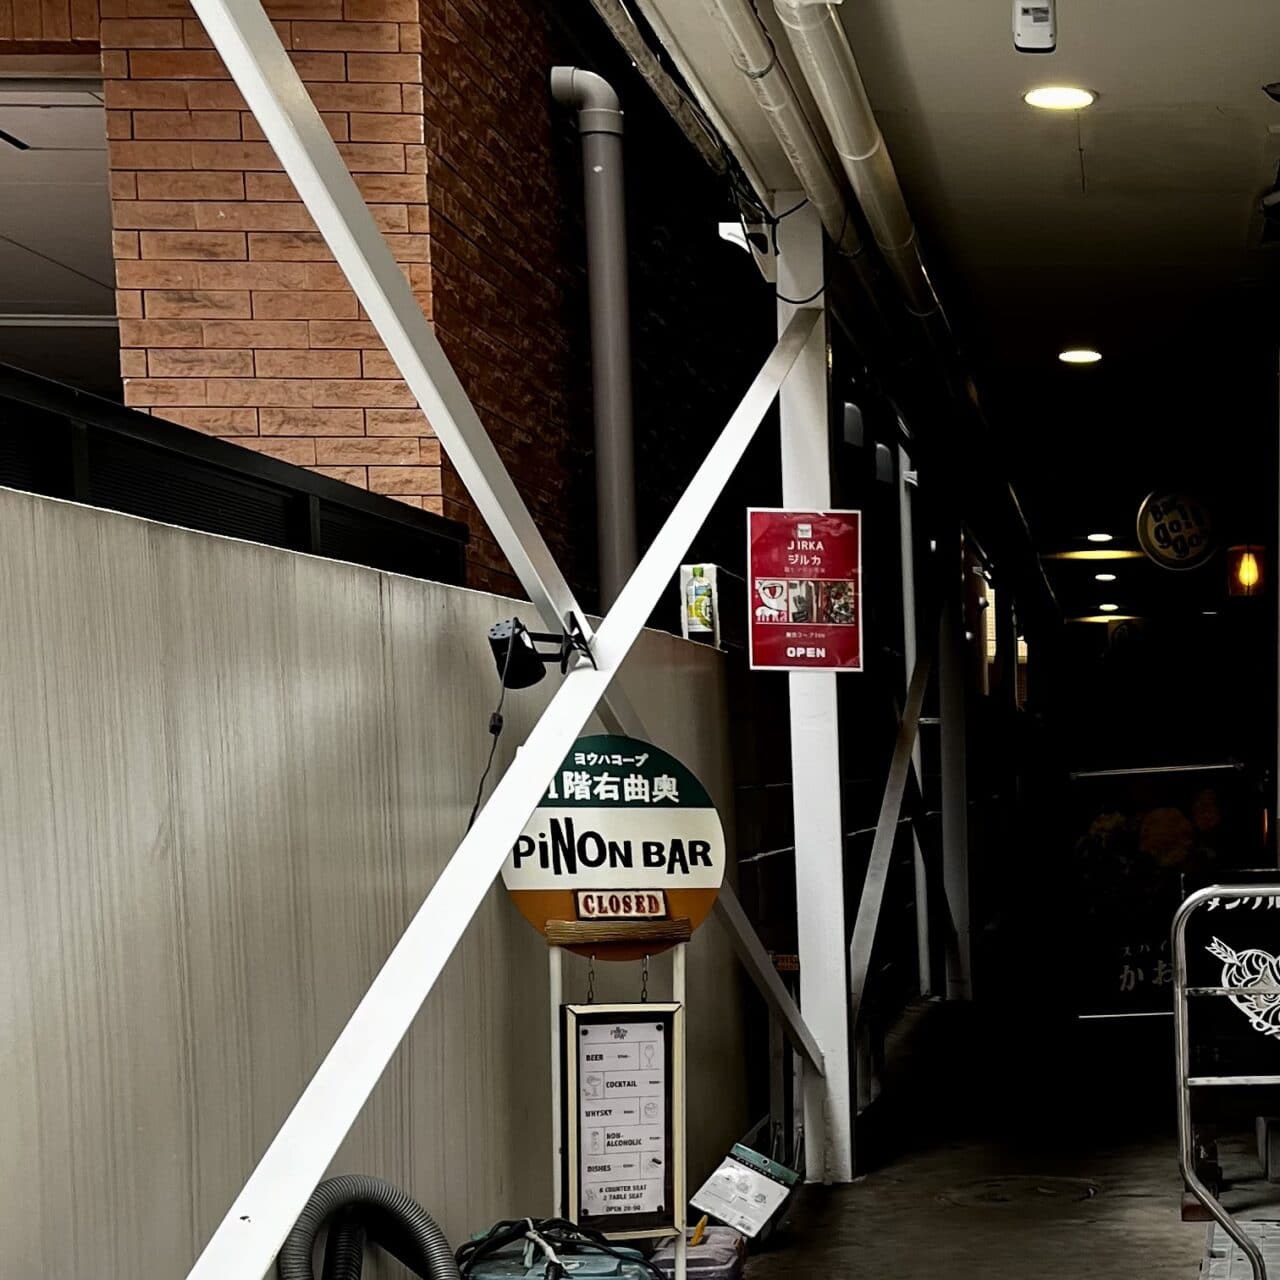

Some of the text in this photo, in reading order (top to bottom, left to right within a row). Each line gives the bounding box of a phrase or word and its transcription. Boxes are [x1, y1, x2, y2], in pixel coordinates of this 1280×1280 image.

[787, 540, 824, 551] JIRKA
[788, 554, 822, 566] ジルカ
[786, 647, 826, 658] OPEN
[574, 752, 649, 767] ヨウハコープ
[548, 771, 680, 803] 1階右曲奥
[642, 839, 713, 874] BAR
[583, 894, 660, 914] CLOSED
[606, 1080, 637, 1088] COCKTAIL
[606, 1139, 642, 1147] ALCOHOLIC
